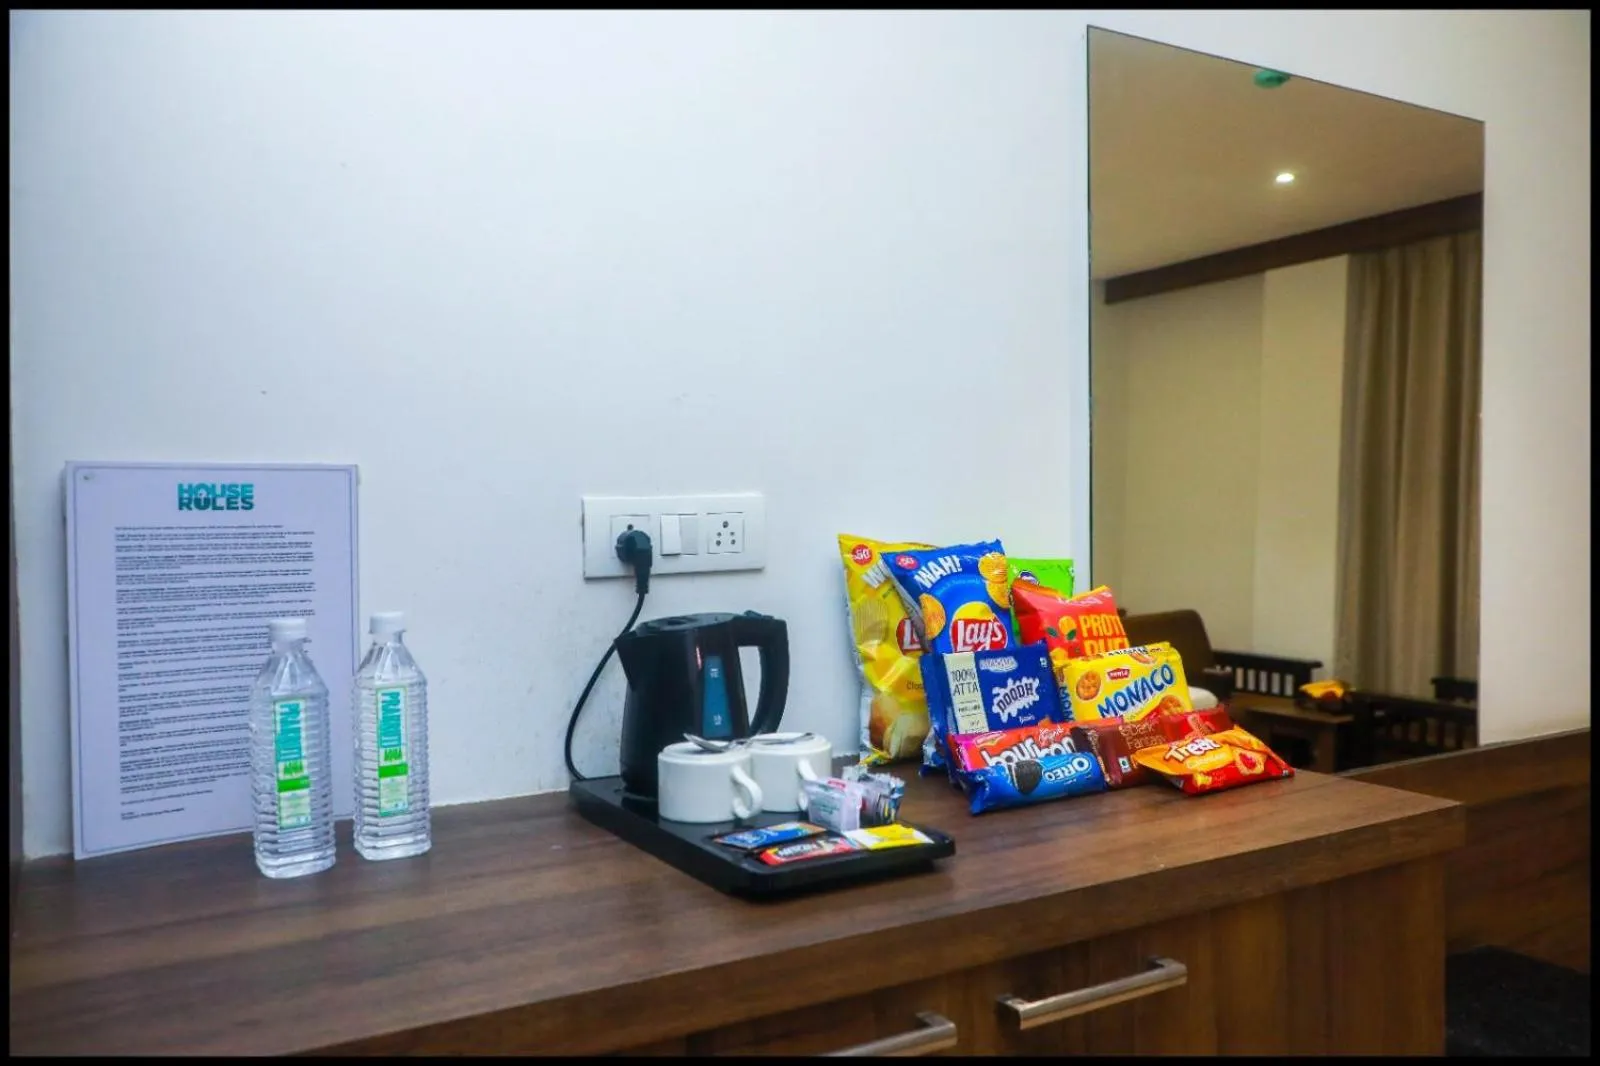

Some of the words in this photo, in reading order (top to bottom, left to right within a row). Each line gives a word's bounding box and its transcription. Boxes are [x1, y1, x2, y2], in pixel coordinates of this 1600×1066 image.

[177, 483, 254, 498] HOUSE
[178, 497, 254, 511] RULES
[914, 555, 963, 589] WAH!
[951, 668, 976, 682] 100%
[953, 682, 979, 696] ATTA
[997, 682, 1033, 713] DOODH
[1097, 664, 1174, 718] MONACO
[1164, 738, 1220, 762] Treat
[1044, 757, 1090, 782] OREO
